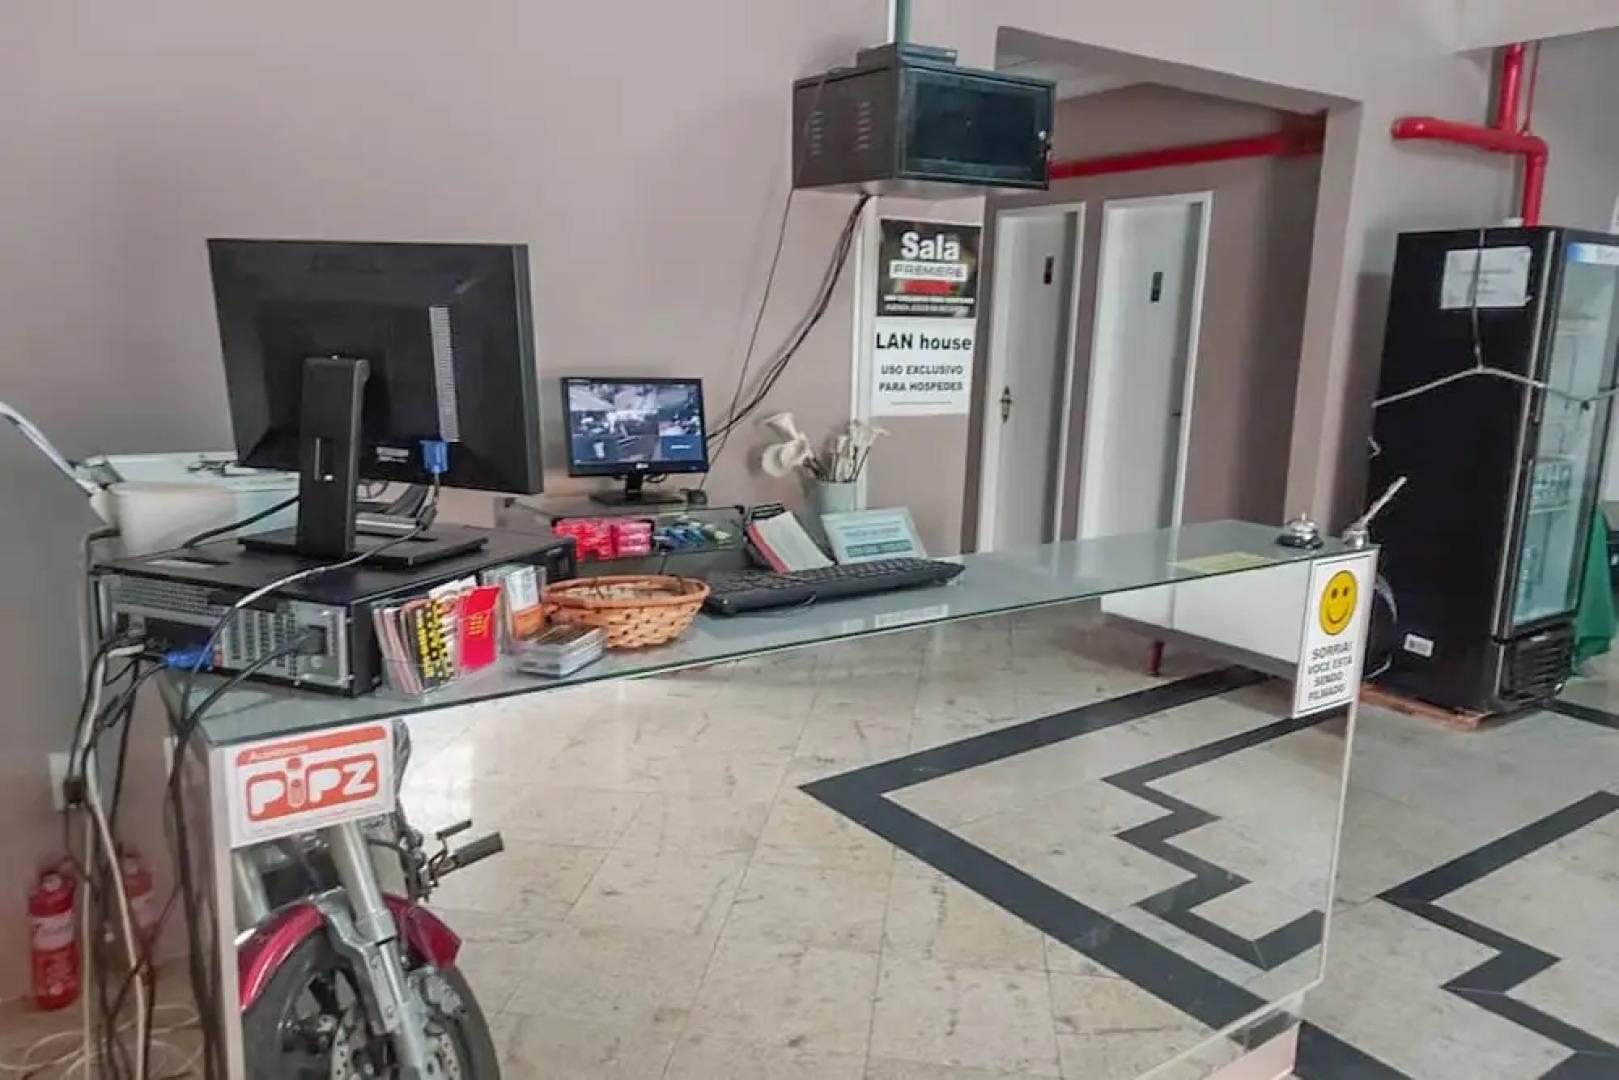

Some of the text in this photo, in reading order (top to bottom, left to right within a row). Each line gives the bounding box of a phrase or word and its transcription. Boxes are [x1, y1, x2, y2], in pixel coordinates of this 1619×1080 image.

[901, 231, 960, 261] Sala
[876, 332, 972, 350] LAN house
[881, 365, 963, 375] USO EXCLUSIVO
[879, 381, 906, 392] PARA
